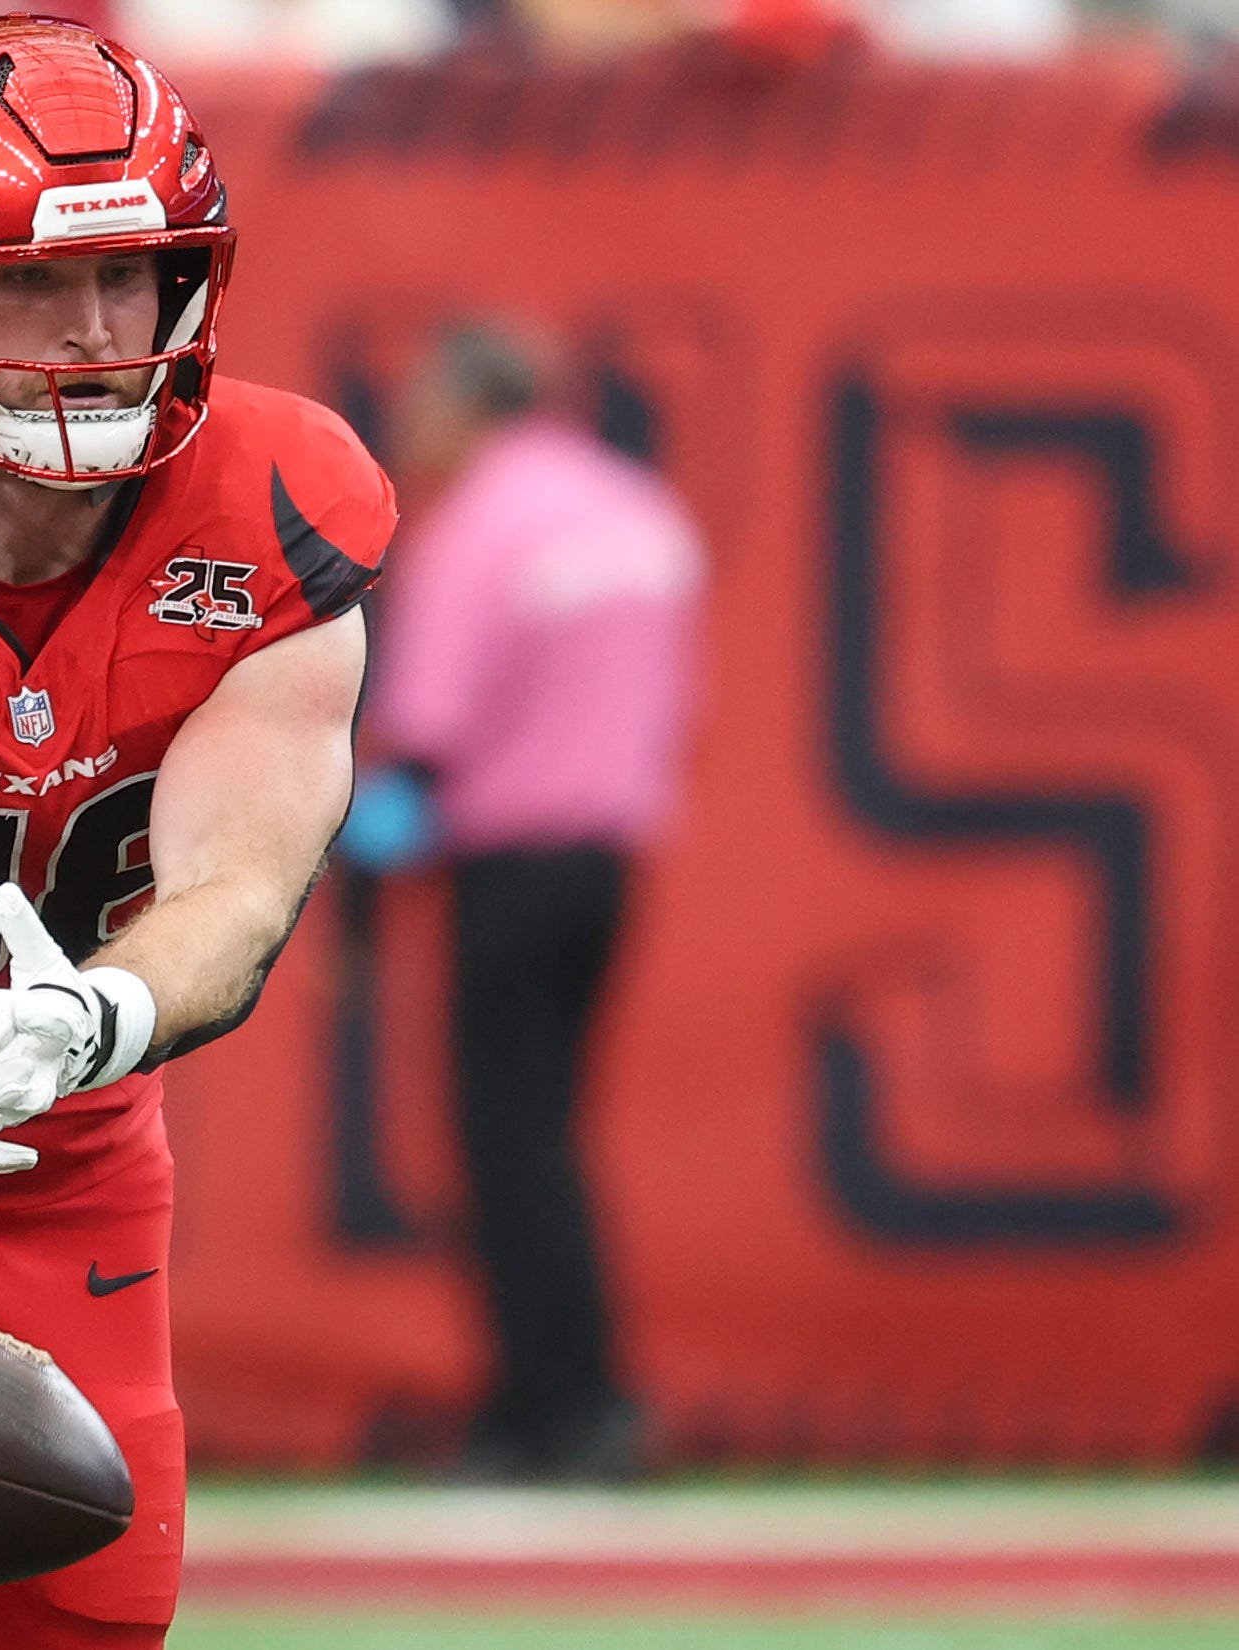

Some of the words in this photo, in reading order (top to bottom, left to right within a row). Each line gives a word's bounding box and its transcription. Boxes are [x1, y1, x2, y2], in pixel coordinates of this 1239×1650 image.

[55, 195, 147, 214] TEXANS
[158, 557, 258, 630] 25
[19, 710, 49, 737] NFL
